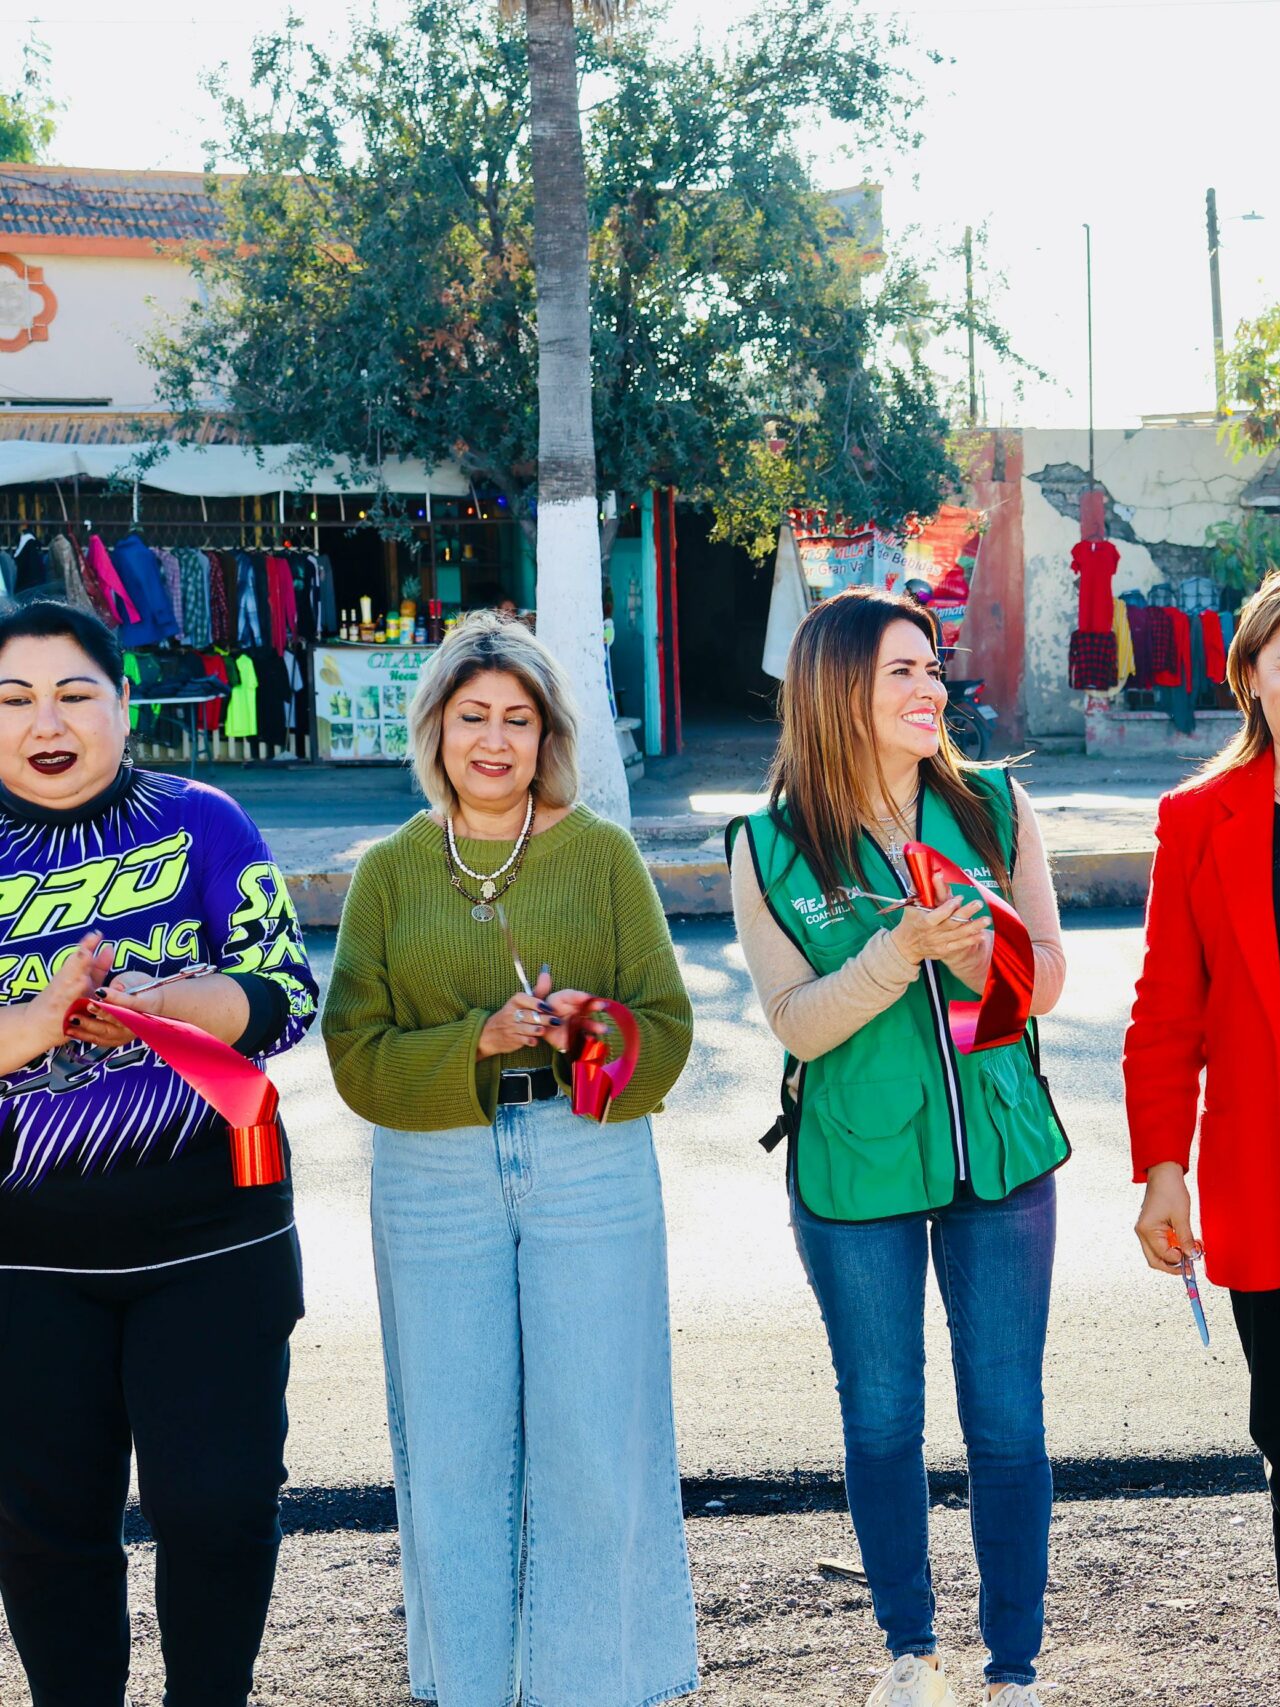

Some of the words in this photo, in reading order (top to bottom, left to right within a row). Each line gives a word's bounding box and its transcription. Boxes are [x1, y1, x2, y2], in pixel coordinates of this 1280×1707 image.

[818, 562, 847, 577] Gran
[891, 551, 941, 576] Bebidas
[367, 651, 434, 669] CLAM
[805, 904, 855, 925] COAHUIL
[0, 918, 202, 1003] ACNG
